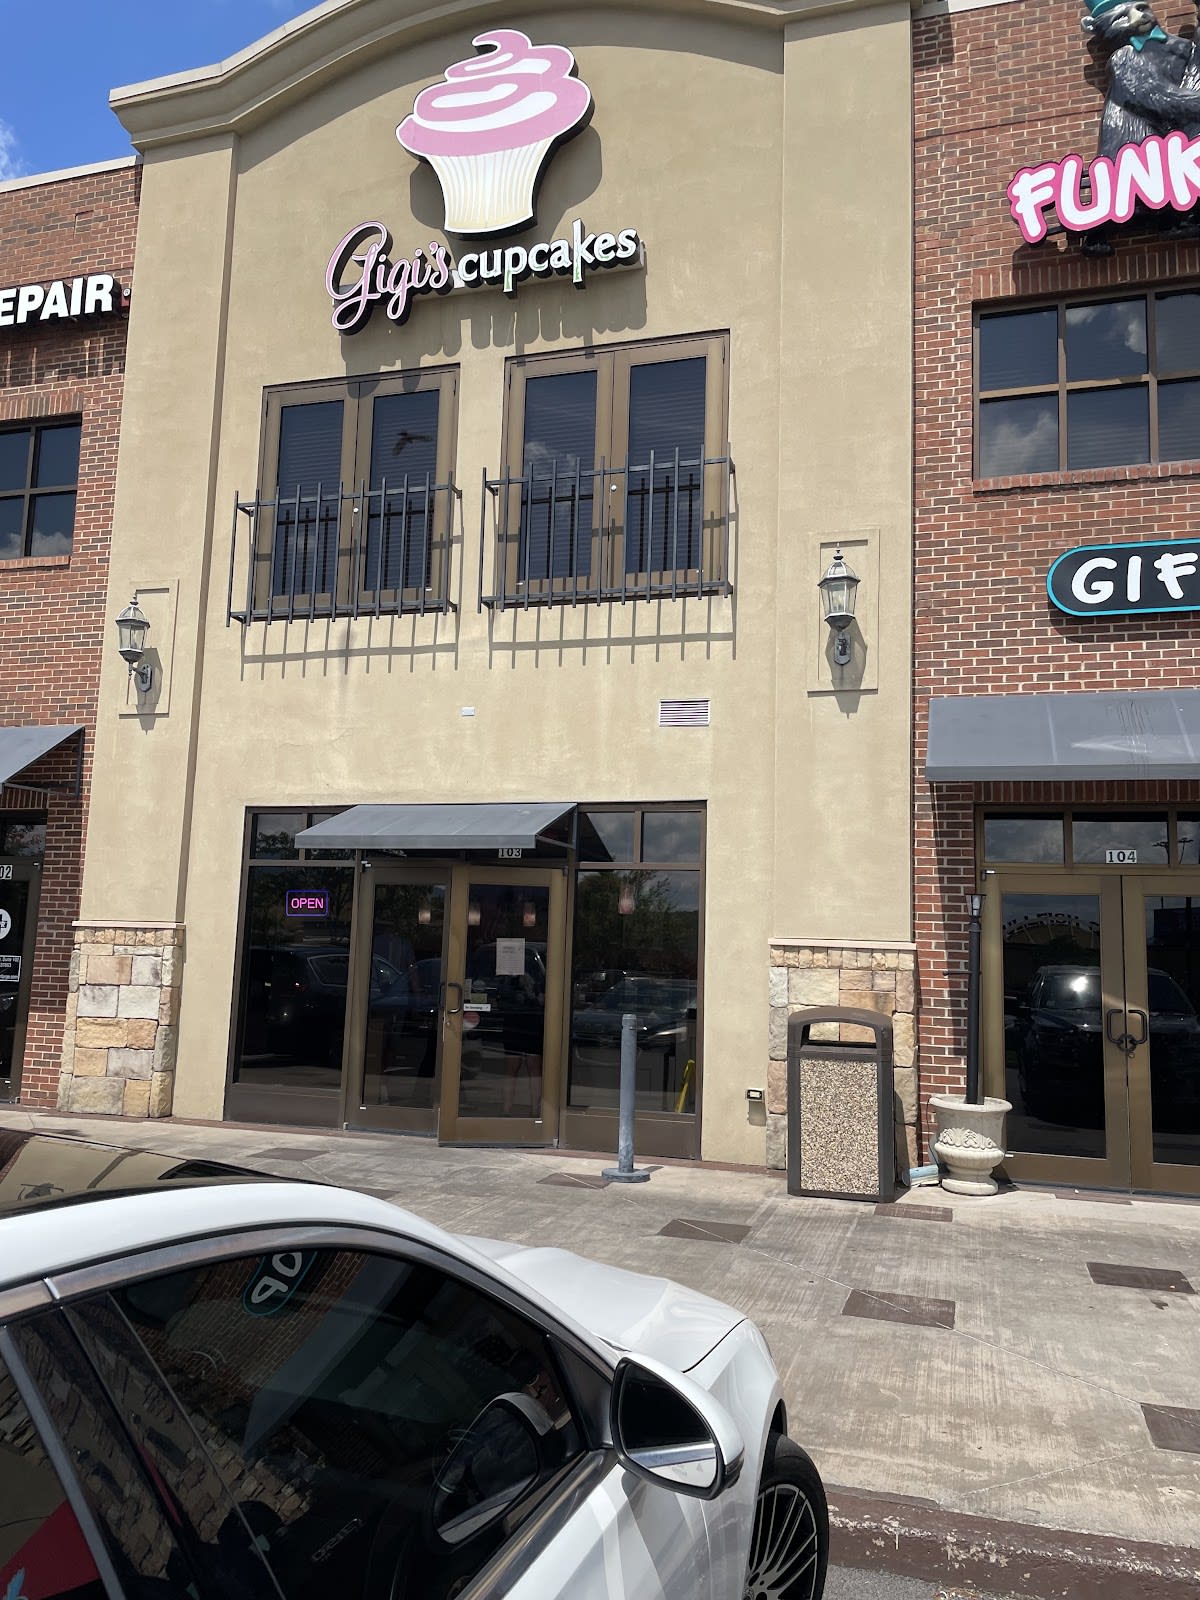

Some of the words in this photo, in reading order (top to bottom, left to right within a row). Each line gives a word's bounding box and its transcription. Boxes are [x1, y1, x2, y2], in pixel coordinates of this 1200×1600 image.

[1008, 131, 1200, 243] FUNK
[325, 220, 449, 330] Gigi's
[458, 218, 638, 293] cupcakes
[0, 274, 114, 327] EPAIR
[1071, 552, 1199, 604] GIF
[499, 848, 521, 857] 103
[1108, 850, 1136, 863] 104
[291, 897, 324, 909] OPEN
